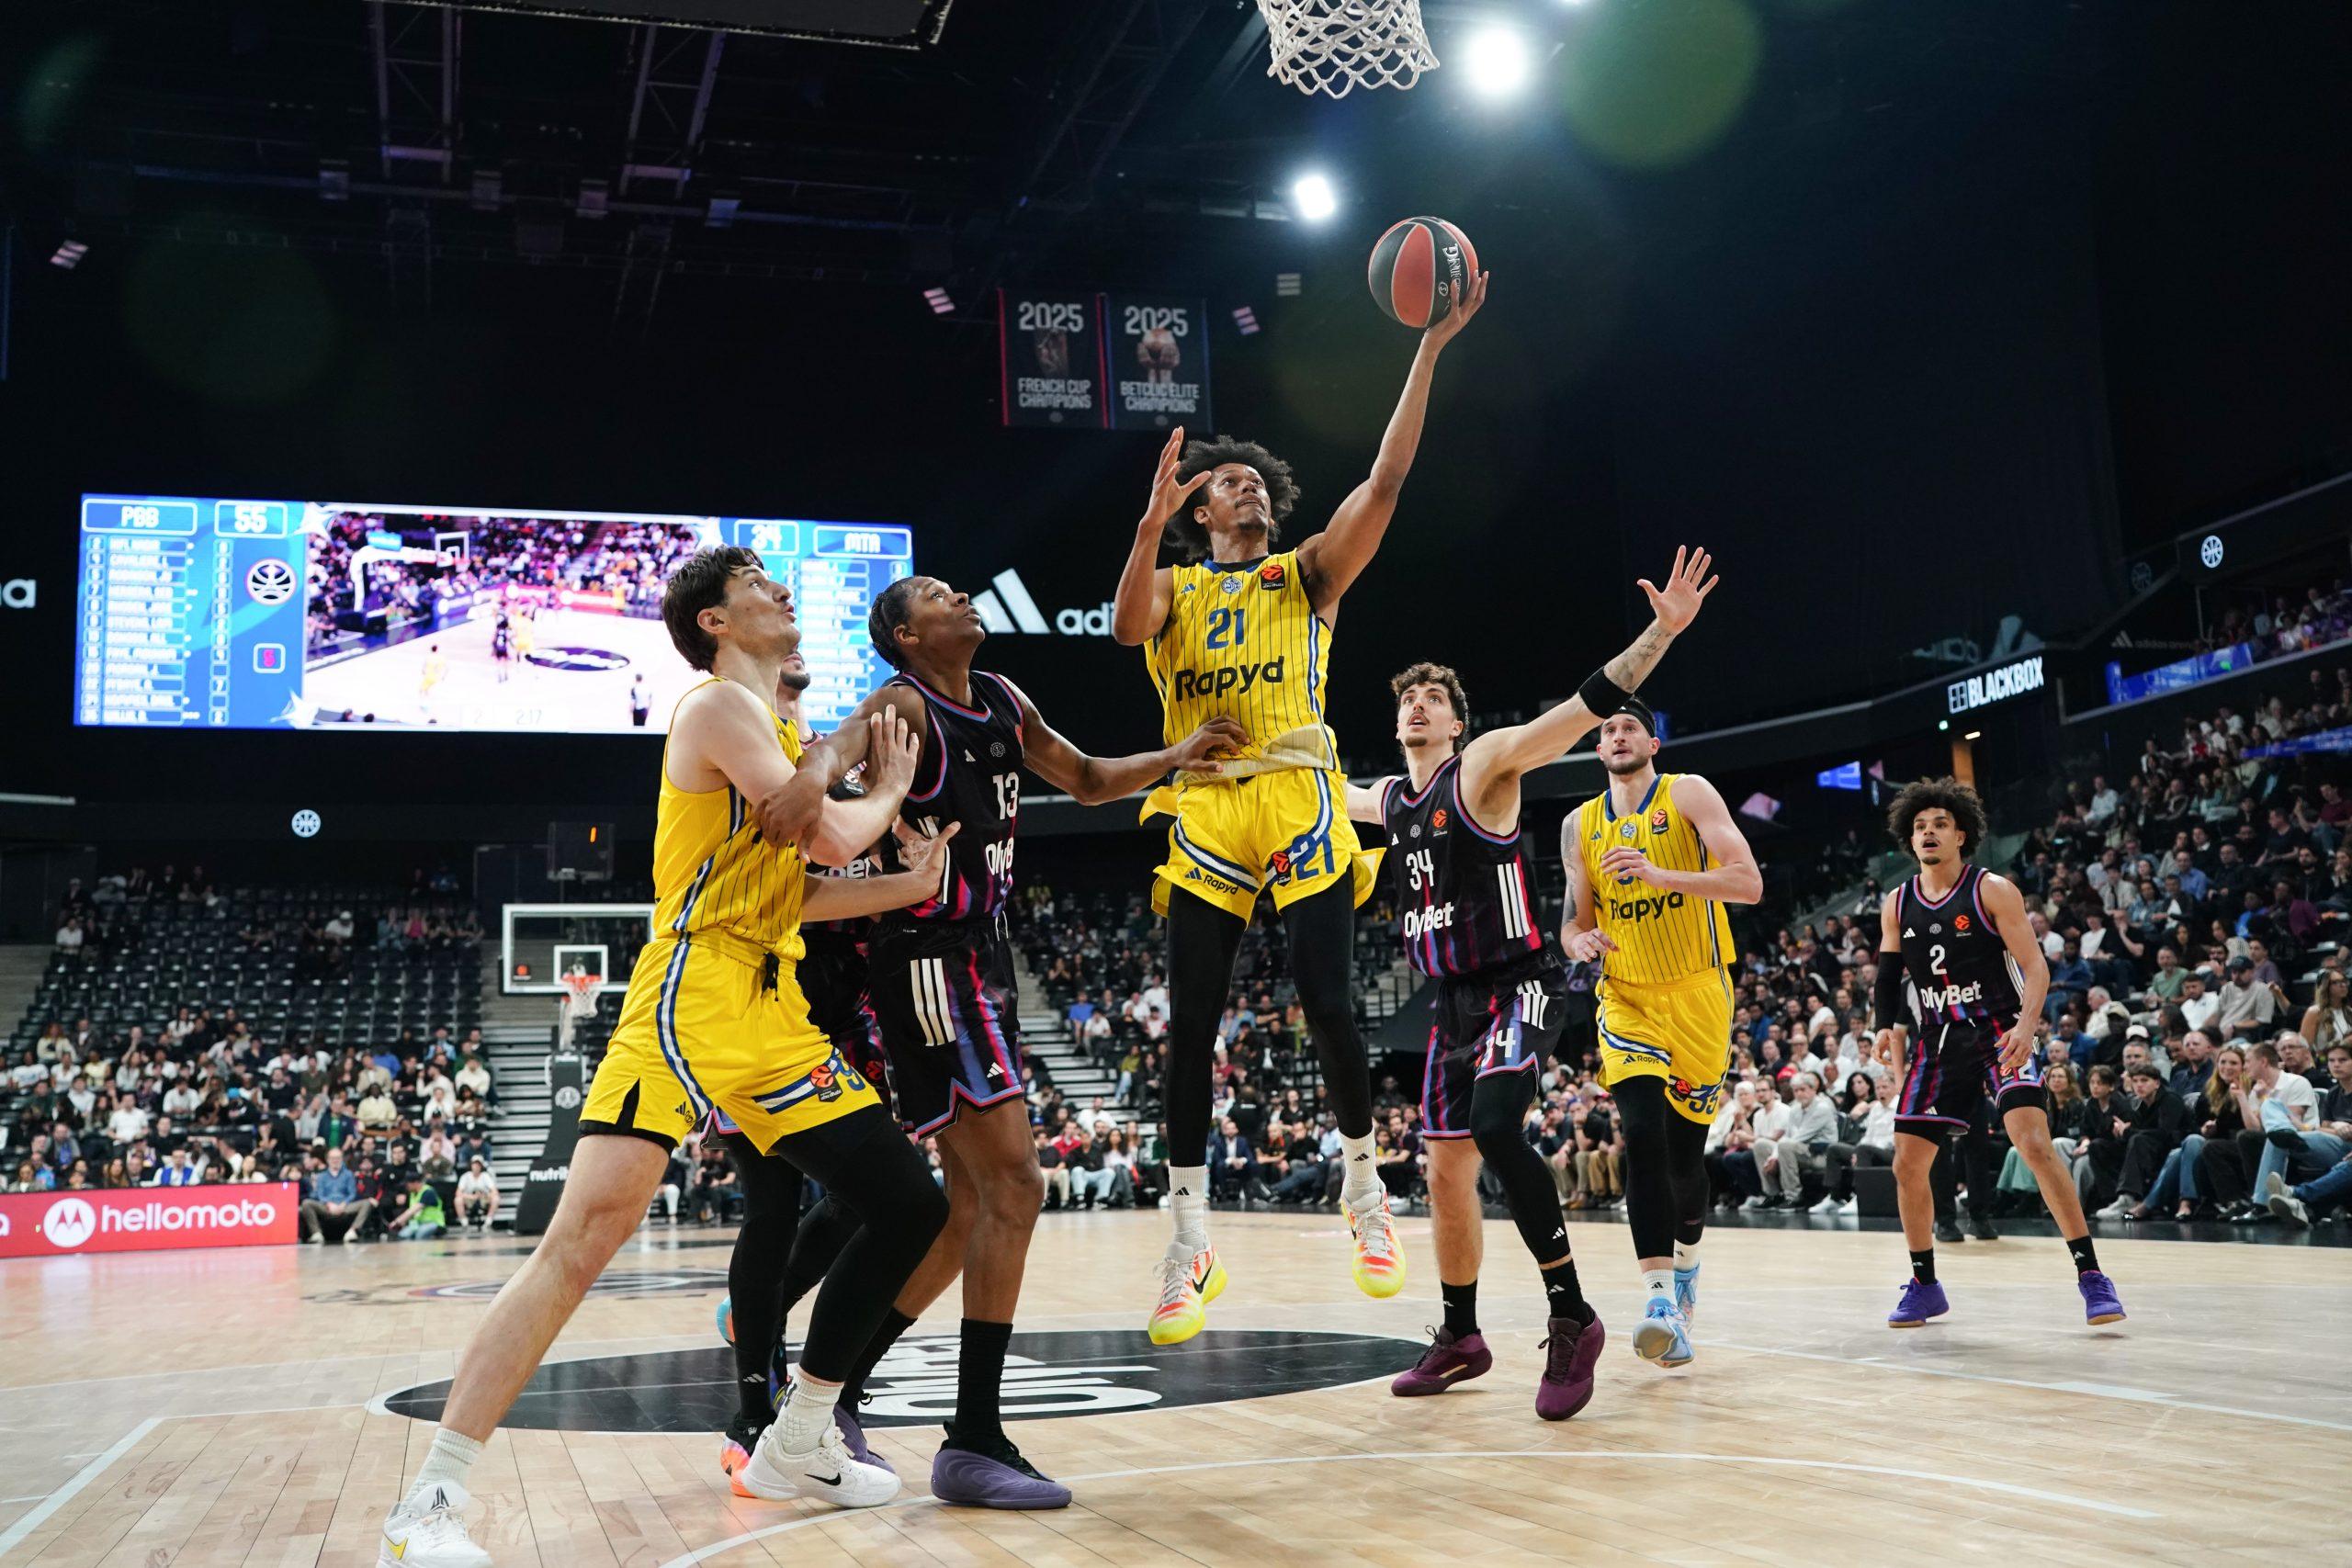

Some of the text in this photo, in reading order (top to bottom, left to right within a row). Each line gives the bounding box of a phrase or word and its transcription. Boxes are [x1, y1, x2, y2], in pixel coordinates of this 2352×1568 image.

[1018, 302, 1084, 333] 2025
[1124, 306, 1189, 337] 2025
[1018, 378, 1091, 394] FRENCH CUP
[1018, 393, 1091, 409] CHAMPIONS
[1172, 383, 1200, 399] ELITE
[1125, 398, 1196, 413] CHAMPIONS
[121, 505, 160, 528] PBB
[234, 505, 268, 533] 55
[1207, 607, 1245, 649] 21
[1176, 655, 1284, 702] Rapyd
[1967, 656, 2044, 708] BLACKBOX
[992, 773, 1019, 820] 13
[1292, 830, 1336, 880] 21
[1406, 848, 1434, 891] 34
[1204, 874, 1239, 896] Rapyd
[1404, 902, 1454, 942] OlyBet
[1929, 944, 1947, 975] 2
[1920, 980, 1983, 1012] OlyBet
[101, 1199, 276, 1233] hellomoto
